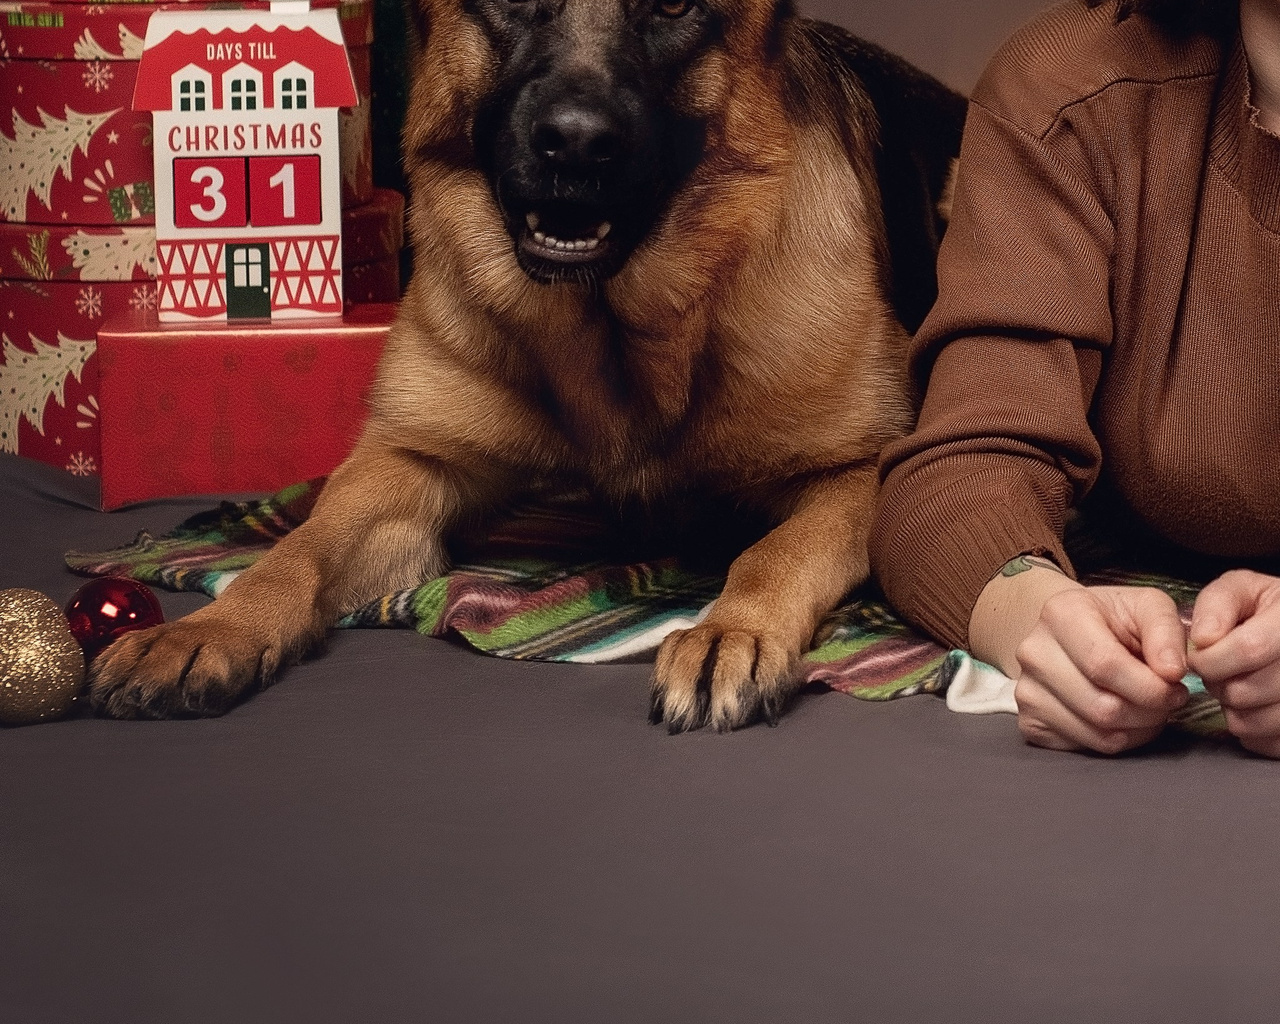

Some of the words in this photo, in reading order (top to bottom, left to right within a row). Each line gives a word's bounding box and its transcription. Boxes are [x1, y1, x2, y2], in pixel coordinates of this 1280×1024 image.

[206, 42, 243, 60] DAYS
[249, 42, 276, 60] TILL
[168, 123, 322, 152] CHRISTMAS
